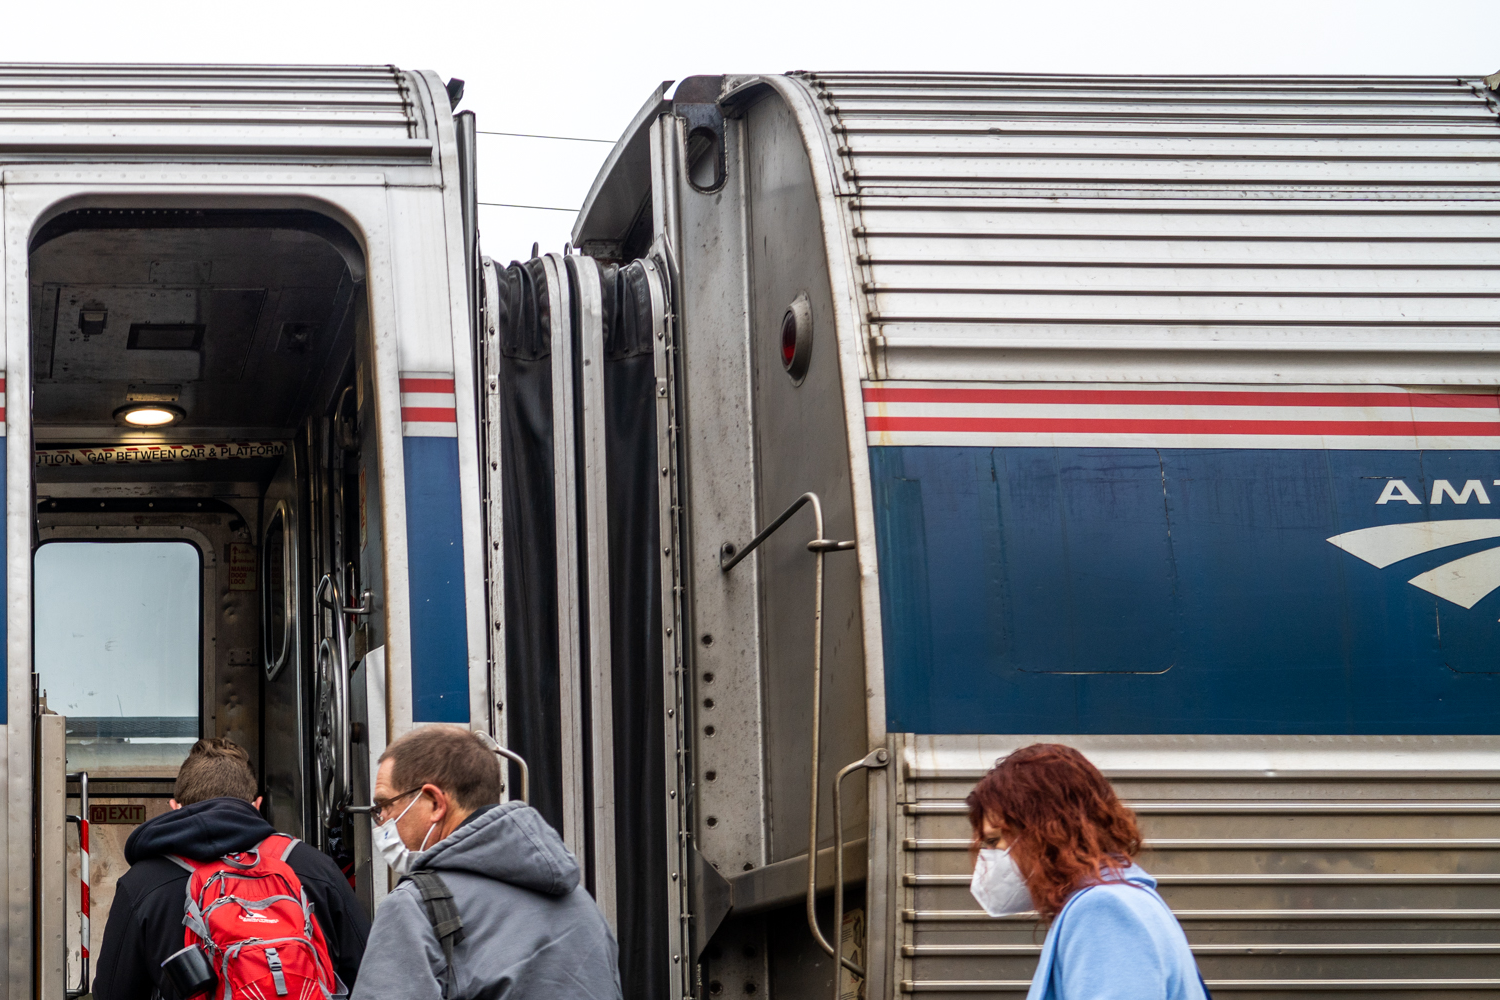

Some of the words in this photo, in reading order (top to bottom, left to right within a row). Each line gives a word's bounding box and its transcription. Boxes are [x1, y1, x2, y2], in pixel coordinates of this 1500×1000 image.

[87, 452, 113, 462] GAP
[116, 449, 176, 461] BETWEEN
[181, 448, 205, 458] CAR
[208, 447, 217, 457] &
[220, 445, 285, 457] PLATFORM
[1374, 479, 1500, 505] AM
[109, 807, 143, 820] EXIT
